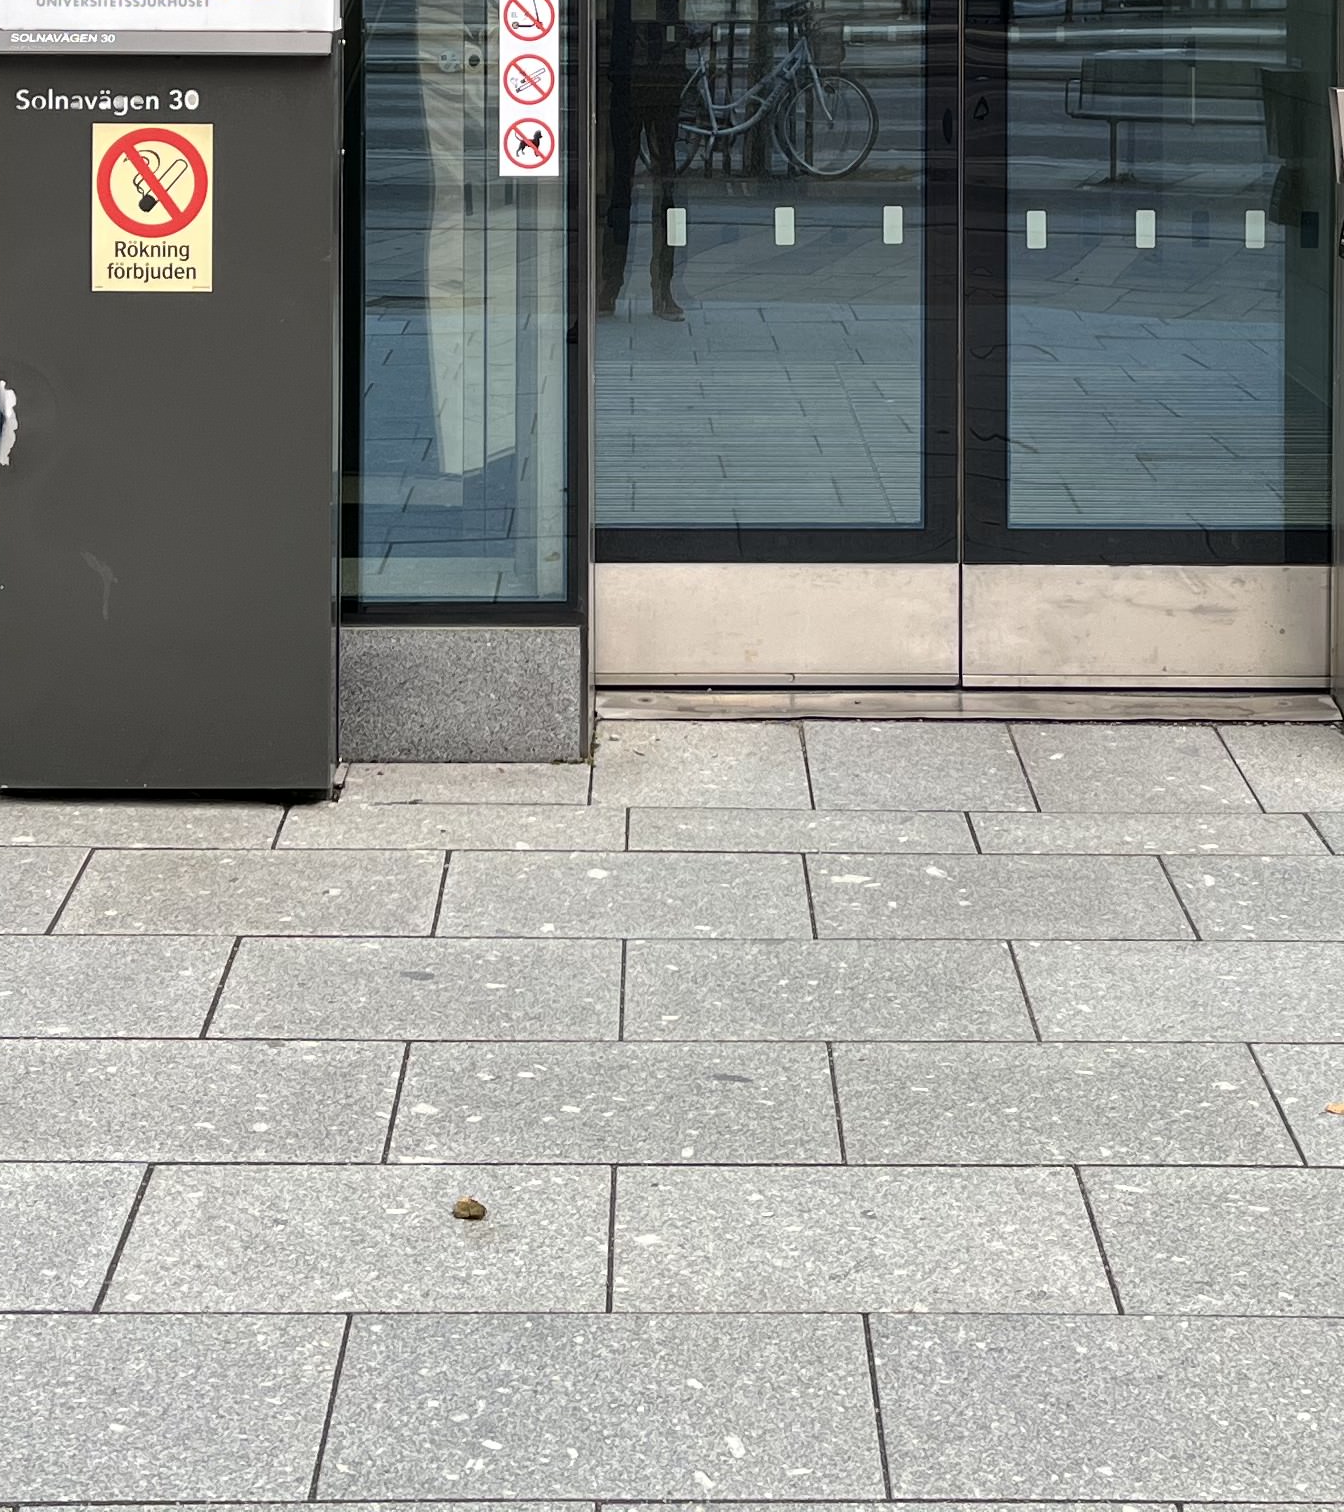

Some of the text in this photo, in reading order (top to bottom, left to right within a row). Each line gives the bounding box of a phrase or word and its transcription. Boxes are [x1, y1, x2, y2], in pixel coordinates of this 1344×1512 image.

[100, 33, 116, 43] 30
[15, 89, 200, 115] Solnavägen 30
[114, 240, 190, 262] Rökning
[107, 262, 197, 284] förbjuden
